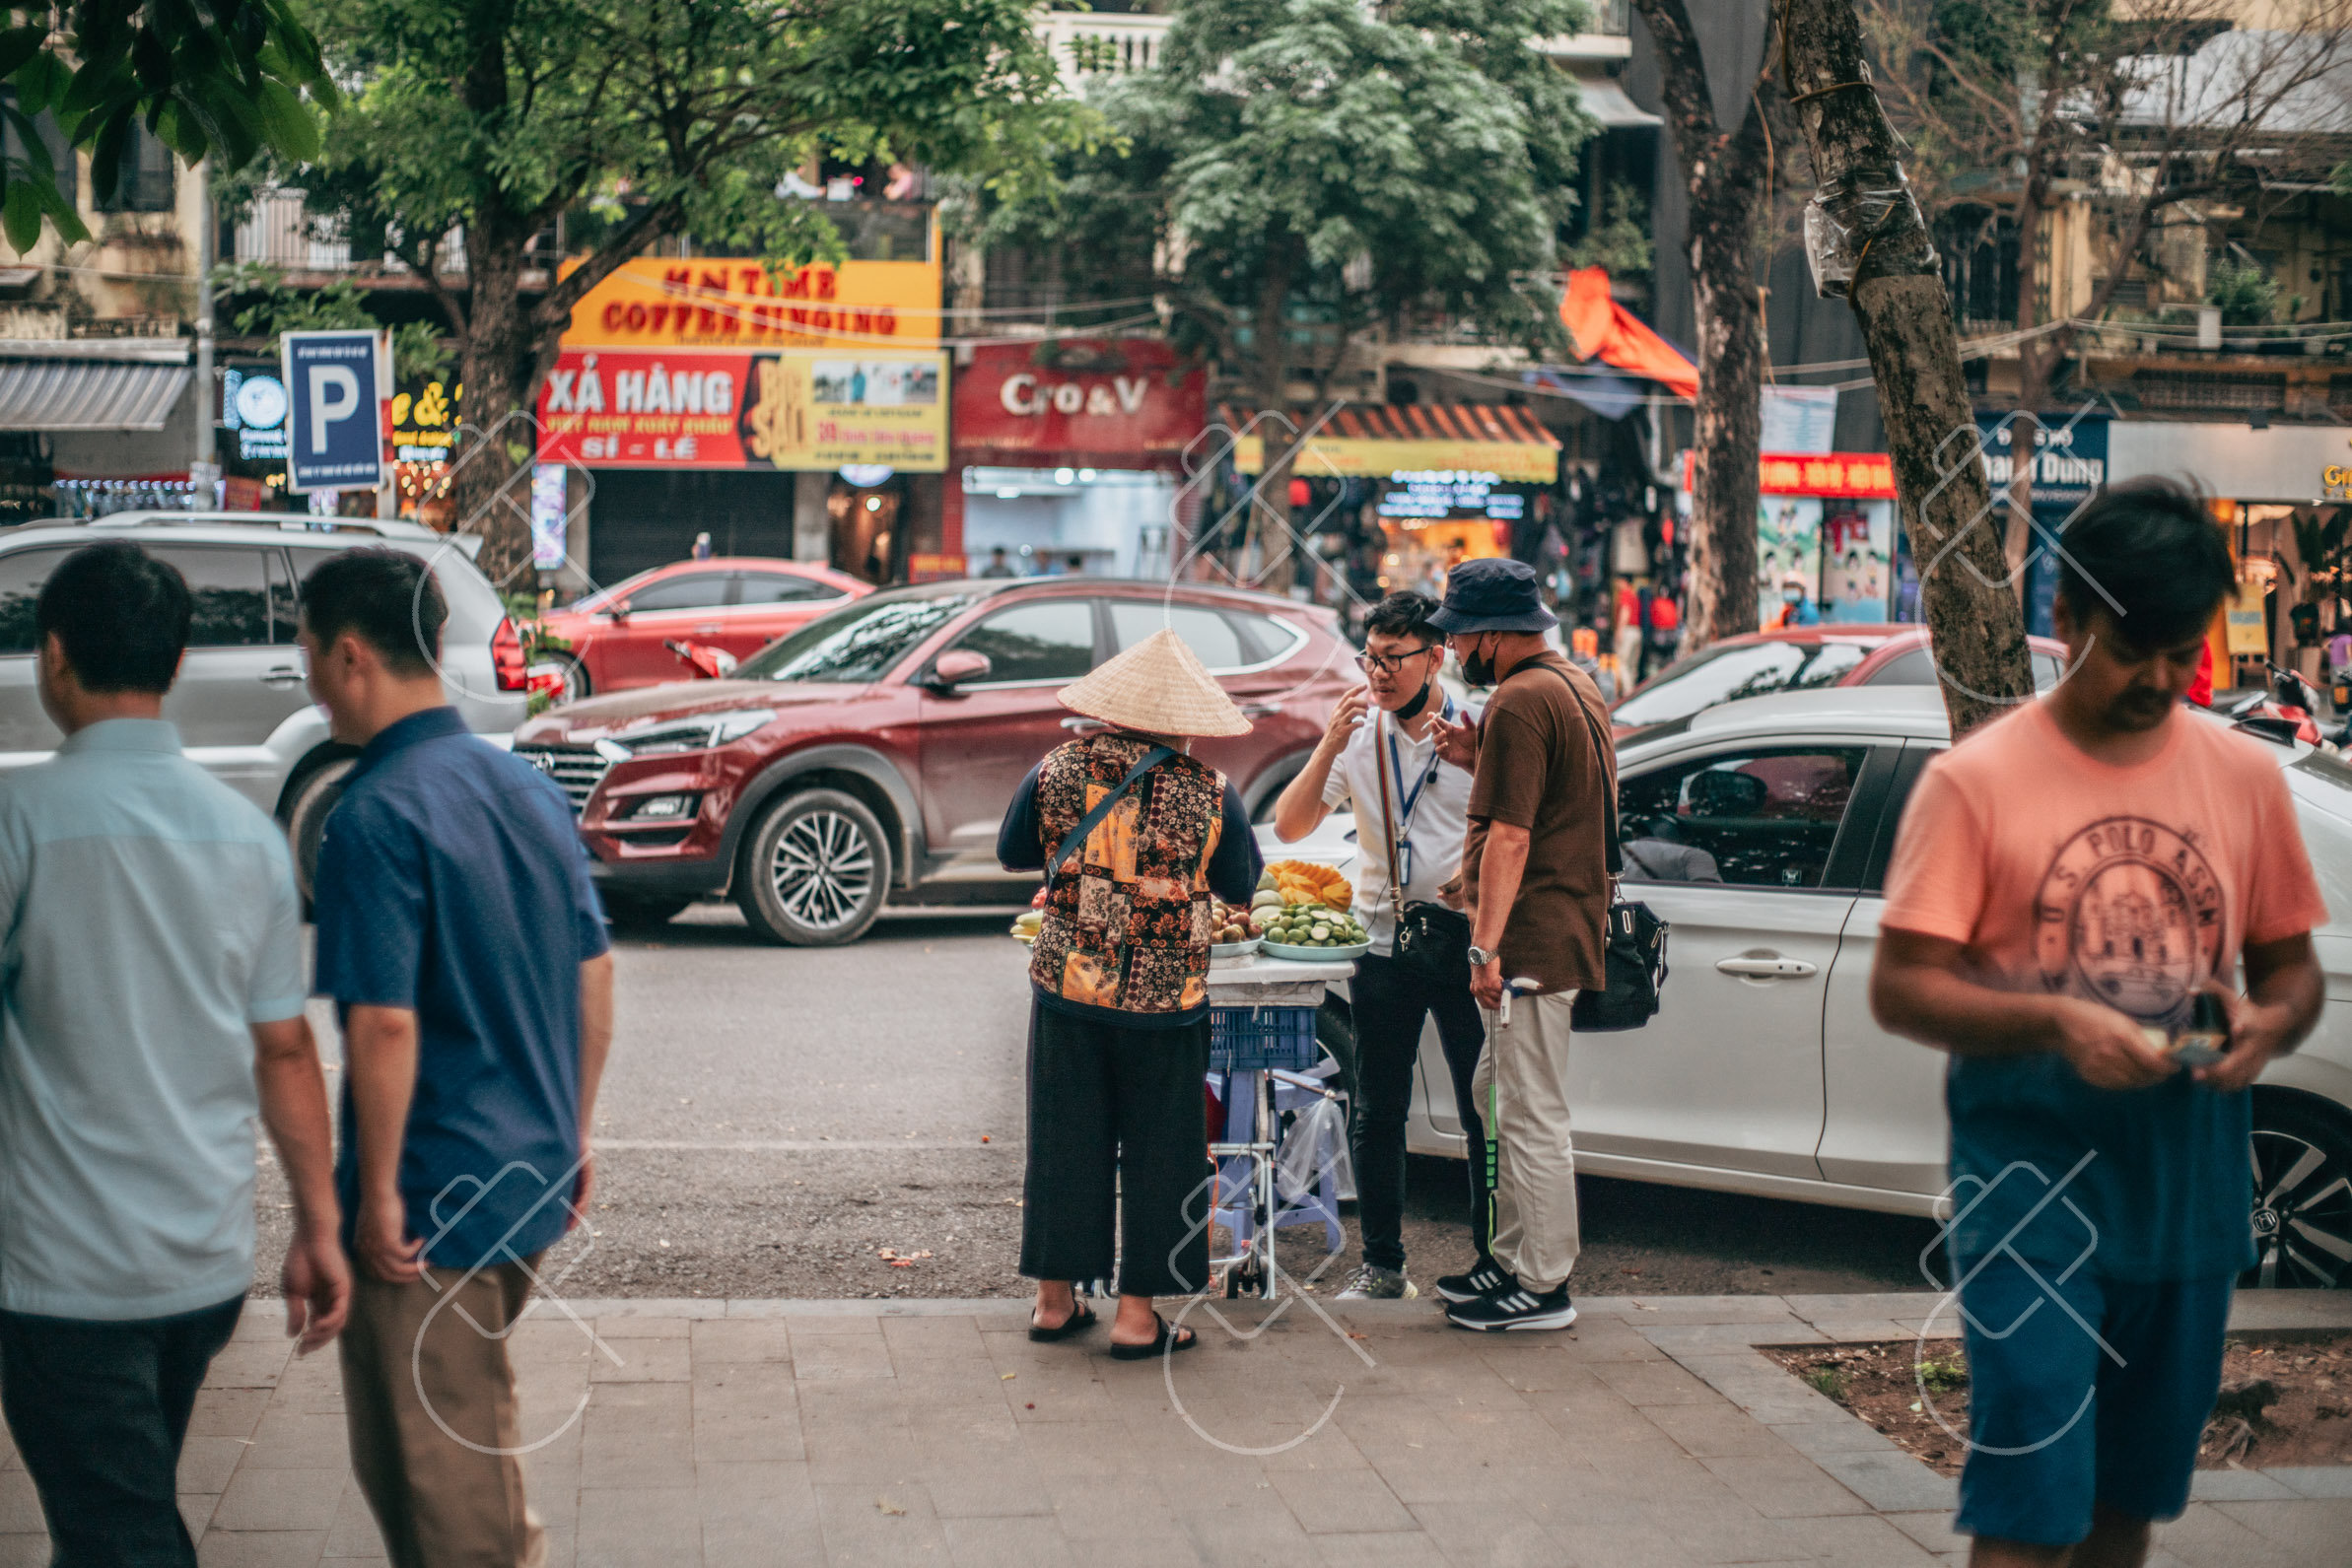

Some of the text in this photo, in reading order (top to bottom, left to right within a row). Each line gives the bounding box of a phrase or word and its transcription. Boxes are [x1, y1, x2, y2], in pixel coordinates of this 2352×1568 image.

[309, 365, 361, 454] P
[546, 353, 606, 414] XẢ
[2086, 824, 2157, 857] POLO
